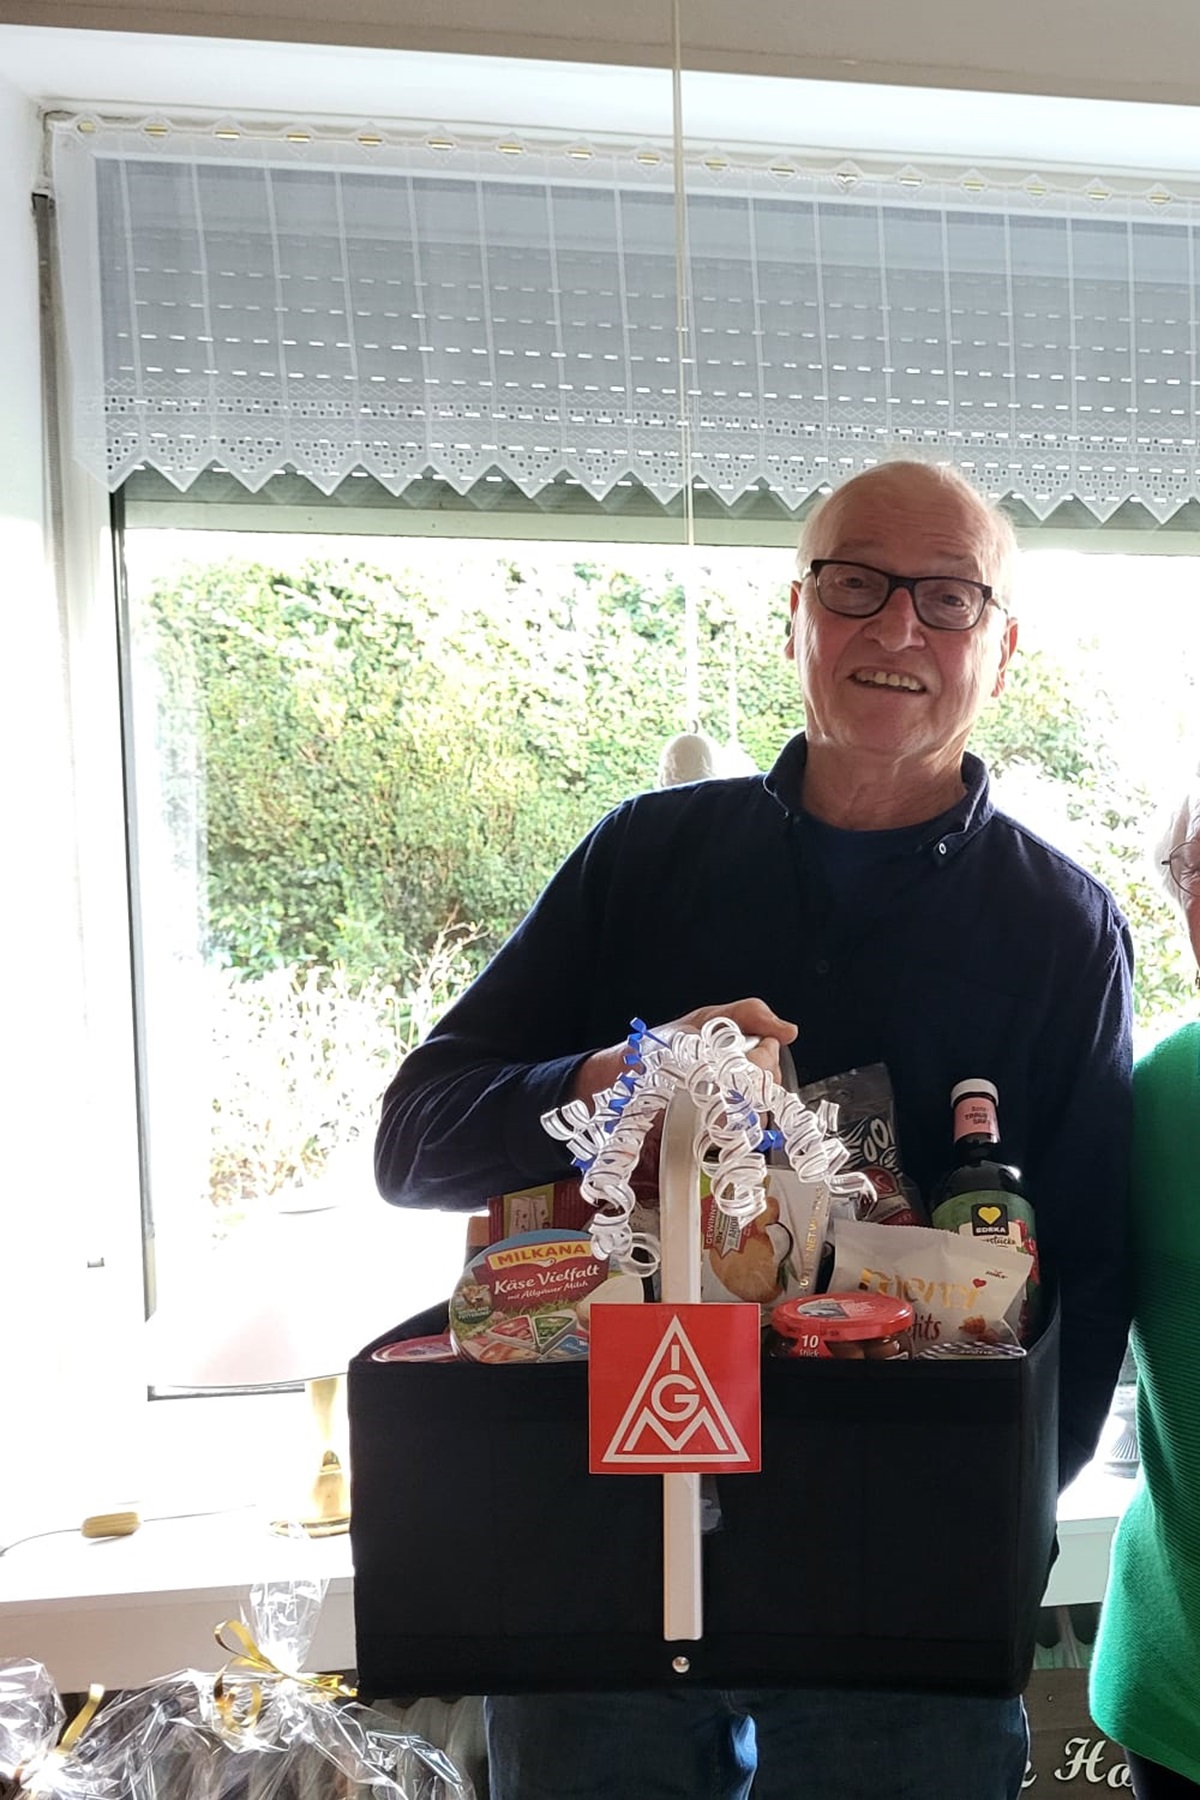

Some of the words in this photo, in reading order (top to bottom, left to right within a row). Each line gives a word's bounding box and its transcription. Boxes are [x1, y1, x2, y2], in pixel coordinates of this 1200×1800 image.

[975, 1226, 1007, 1234] EDEKA
[497, 1244, 587, 1266] MILKANA
[494, 1277, 536, 1295] Käse
[537, 1264, 601, 1286] Vielfalt
[801, 1334, 820, 1349] 10
